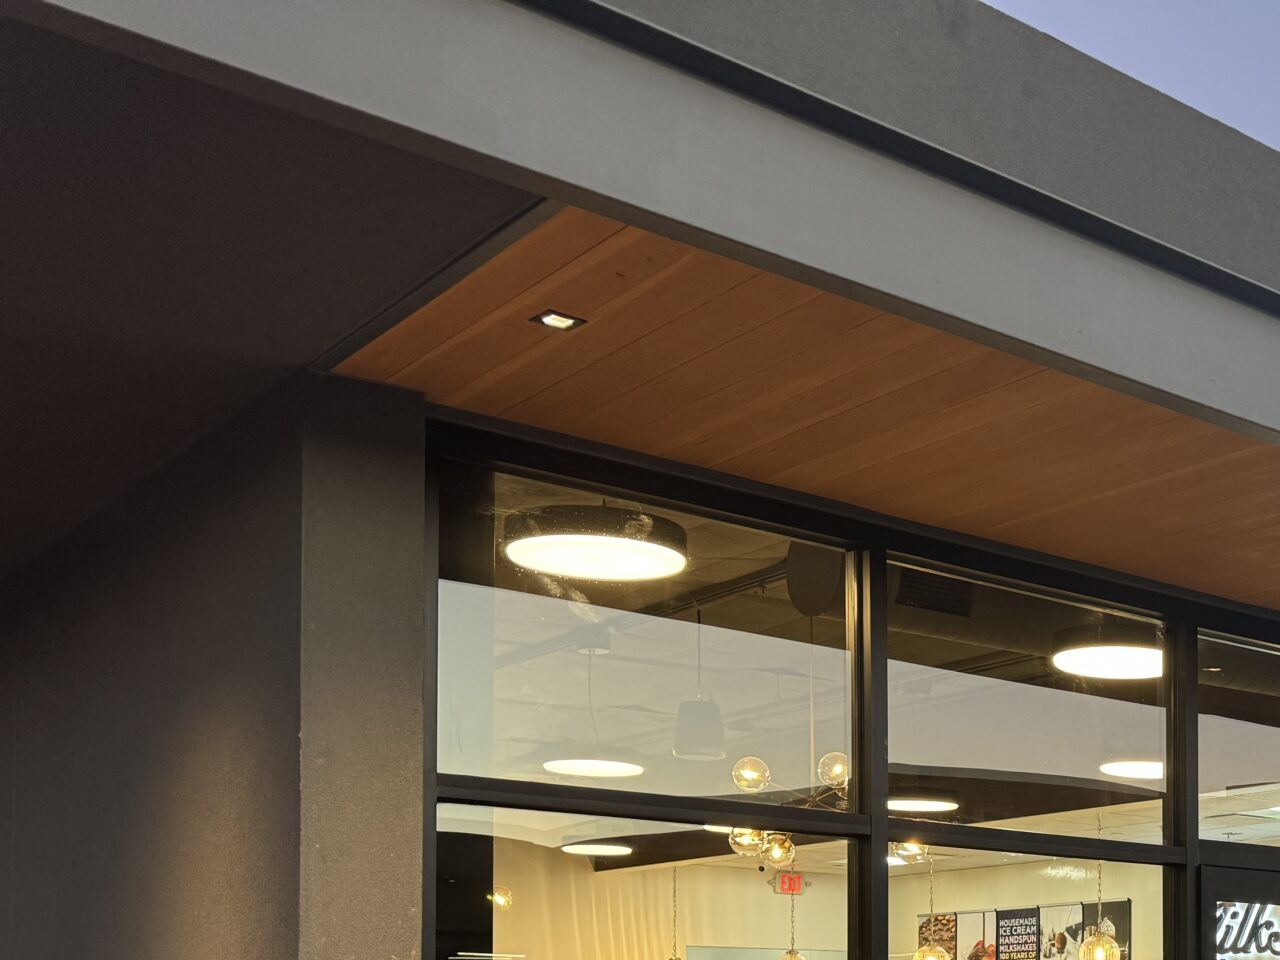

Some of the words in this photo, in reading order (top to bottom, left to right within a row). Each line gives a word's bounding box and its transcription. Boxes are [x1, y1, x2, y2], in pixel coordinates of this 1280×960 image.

[781, 873, 802, 893] EXIT
[1000, 917, 1037, 927] HOUSEMADE
[1000, 927, 1011, 935] ICE
[1012, 926, 1037, 935] CREAM
[1000, 935, 1037, 944] HANDSPUN
[1000, 944, 1037, 952] MILKSHAKES
